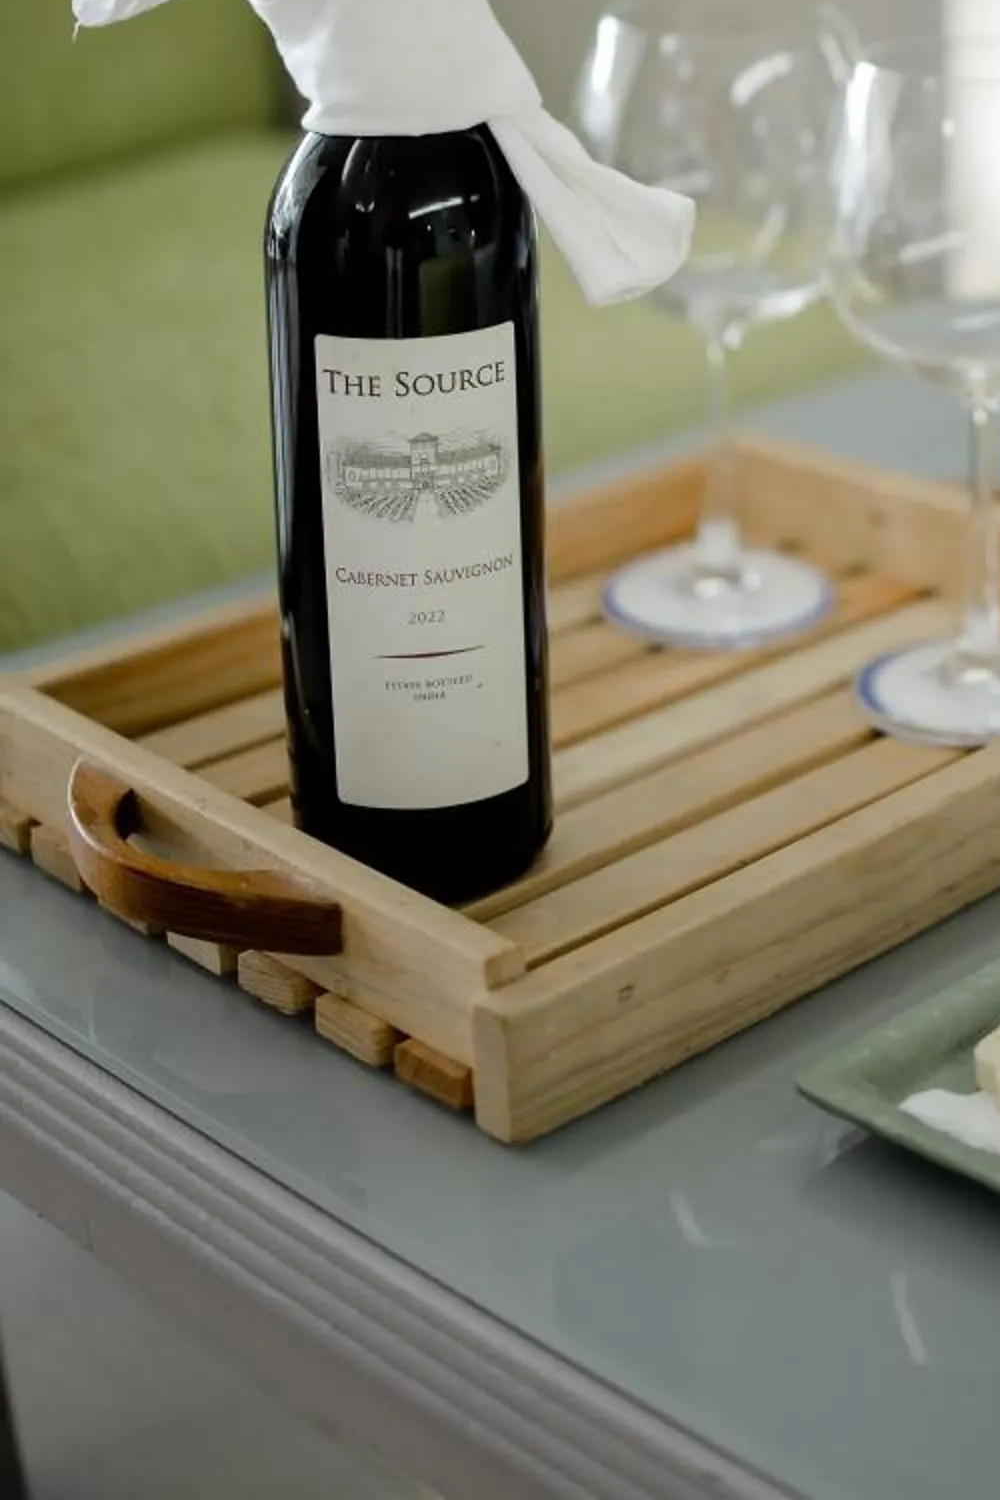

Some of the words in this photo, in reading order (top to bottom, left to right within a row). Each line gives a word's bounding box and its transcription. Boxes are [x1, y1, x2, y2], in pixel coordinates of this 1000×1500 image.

[322, 368, 381, 398] THE
[395, 360, 505, 397] SOURCE
[335, 567, 419, 587] CABERNET
[424, 554, 514, 586] SAUVIGNON
[408, 610, 446, 626] 2022
